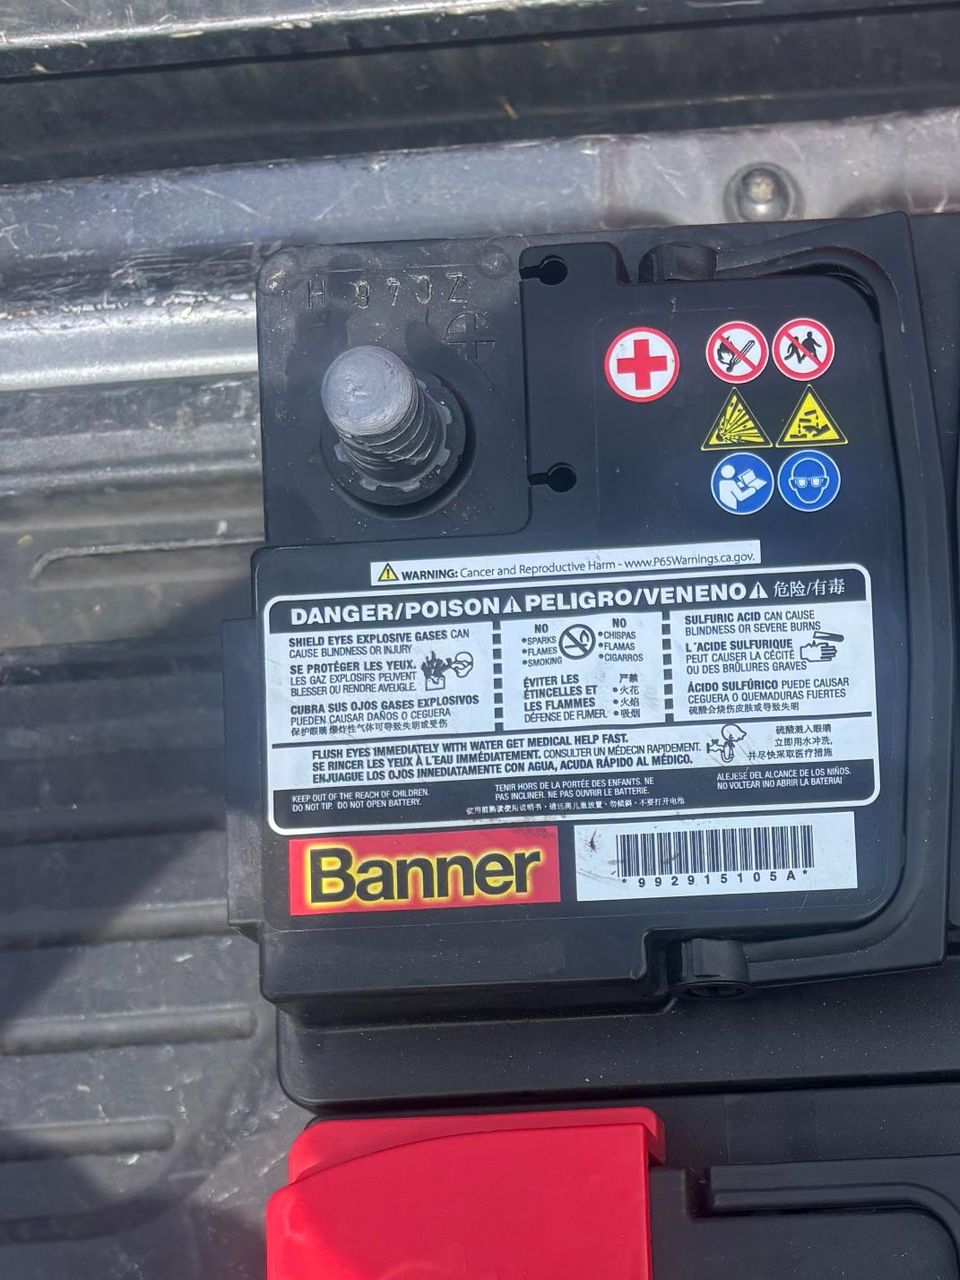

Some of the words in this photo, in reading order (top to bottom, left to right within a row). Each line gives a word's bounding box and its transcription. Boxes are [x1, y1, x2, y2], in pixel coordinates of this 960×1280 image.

[401, 569, 458, 581] WARNING:
[460, 567, 495, 578] Cancer
[497, 564, 516, 576] and
[519, 562, 586, 576] Reproductive
[588, 561, 616, 571] Harm
[525, 582, 747, 613] PELIGRO/VENENO
[291, 597, 499, 626] DANGER/POISON
[684, 612, 734, 625] SULFURIC
[736, 611, 761, 622] ACID
[763, 610, 782, 621] CAN
[785, 609, 815, 620] CAUSE
[534, 623, 548, 633] NO
[611, 617, 627, 628] NO
[685, 624, 735, 636] BLINDNESS
[737, 623, 751, 633] OR
[753, 622, 787, 632] SEVERE
[790, 620, 821, 632] BURNS
[288, 636, 324, 649] SHIELD
[327, 634, 353, 645] EYES
[356, 632, 412, 644] EXPLOSIVE
[414, 629, 447, 641] GASES
[450, 628, 469, 639] CAN
[289, 664, 303, 675] SE
[306, 660, 360, 674] PROTÉGER
[363, 660, 383, 671] LES
[385, 658, 416, 670] YEUX.
[687, 680, 718, 693] ÁCIDO
[721, 677, 778, 691] SULFÚRICO
[781, 678, 810, 689] PUEDE
[813, 676, 849, 688] CAUSAR
[290, 703, 325, 715] CUBRA
[327, 701, 348, 713] SUS
[350, 700, 377, 711] OJOS
[380, 699, 414, 711] GASES
[417, 694, 479, 708] EXPLOSIVOS
[312, 748, 343, 759] FLUSH
[345, 747, 370, 757] EYES
[372, 742, 439, 756] IMMEDIATELY
[441, 741, 467, 752] WITH
[469, 739, 503, 752] WATER
[505, 738, 524, 748] GET
[527, 735, 572, 747] MEDICAL
[574, 734, 599, 745] HELP
[601, 733, 628, 743] FAST.
[309, 846, 541, 904] Banner
